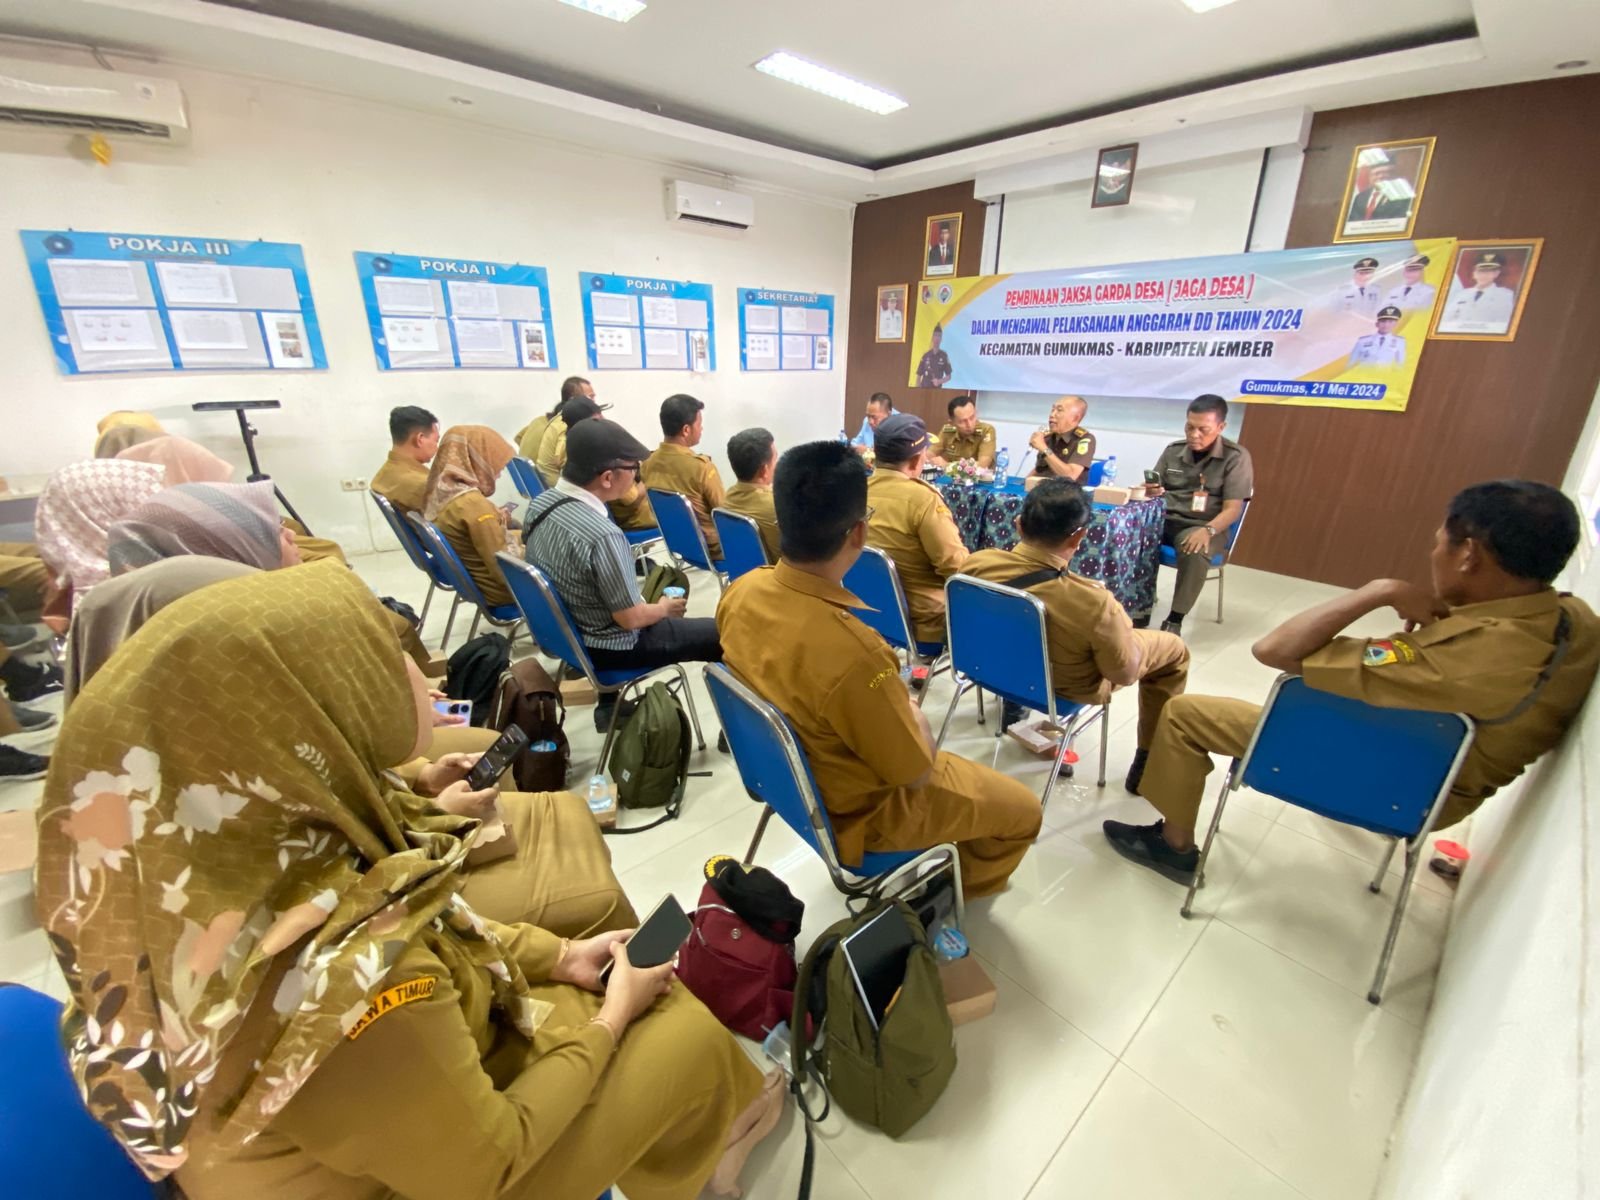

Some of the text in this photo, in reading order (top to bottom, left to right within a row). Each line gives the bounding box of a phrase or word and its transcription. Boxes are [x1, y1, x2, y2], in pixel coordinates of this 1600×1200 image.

[108, 236, 231, 255] POKJA III
[420, 260, 496, 276] POKJA II
[626, 279, 668, 291] POKJA
[1005, 288, 1059, 307] PEMBINAAN
[1061, 285, 1092, 304] JAKSA
[1094, 283, 1132, 302] GARDA
[1134, 281, 1165, 300] DESA
[1209, 275, 1246, 297] DESA
[757, 291, 819, 304] SEKRETARIAT
[971, 308, 1303, 335] DALAM MENGAWAL PELAKSANAAN ANGGARAN DD TAHUN 2024
[979, 342, 1042, 356] KECAMATAN
[1043, 342, 1115, 356] GUMUKMAS
[1124, 341, 1207, 357] KABUPATEN
[1208, 341, 1274, 357] JEMBER
[1245, 380, 1382, 398] Gumukmas, 21 Mei 2024
[395, 980, 434, 1002] TIMUR
